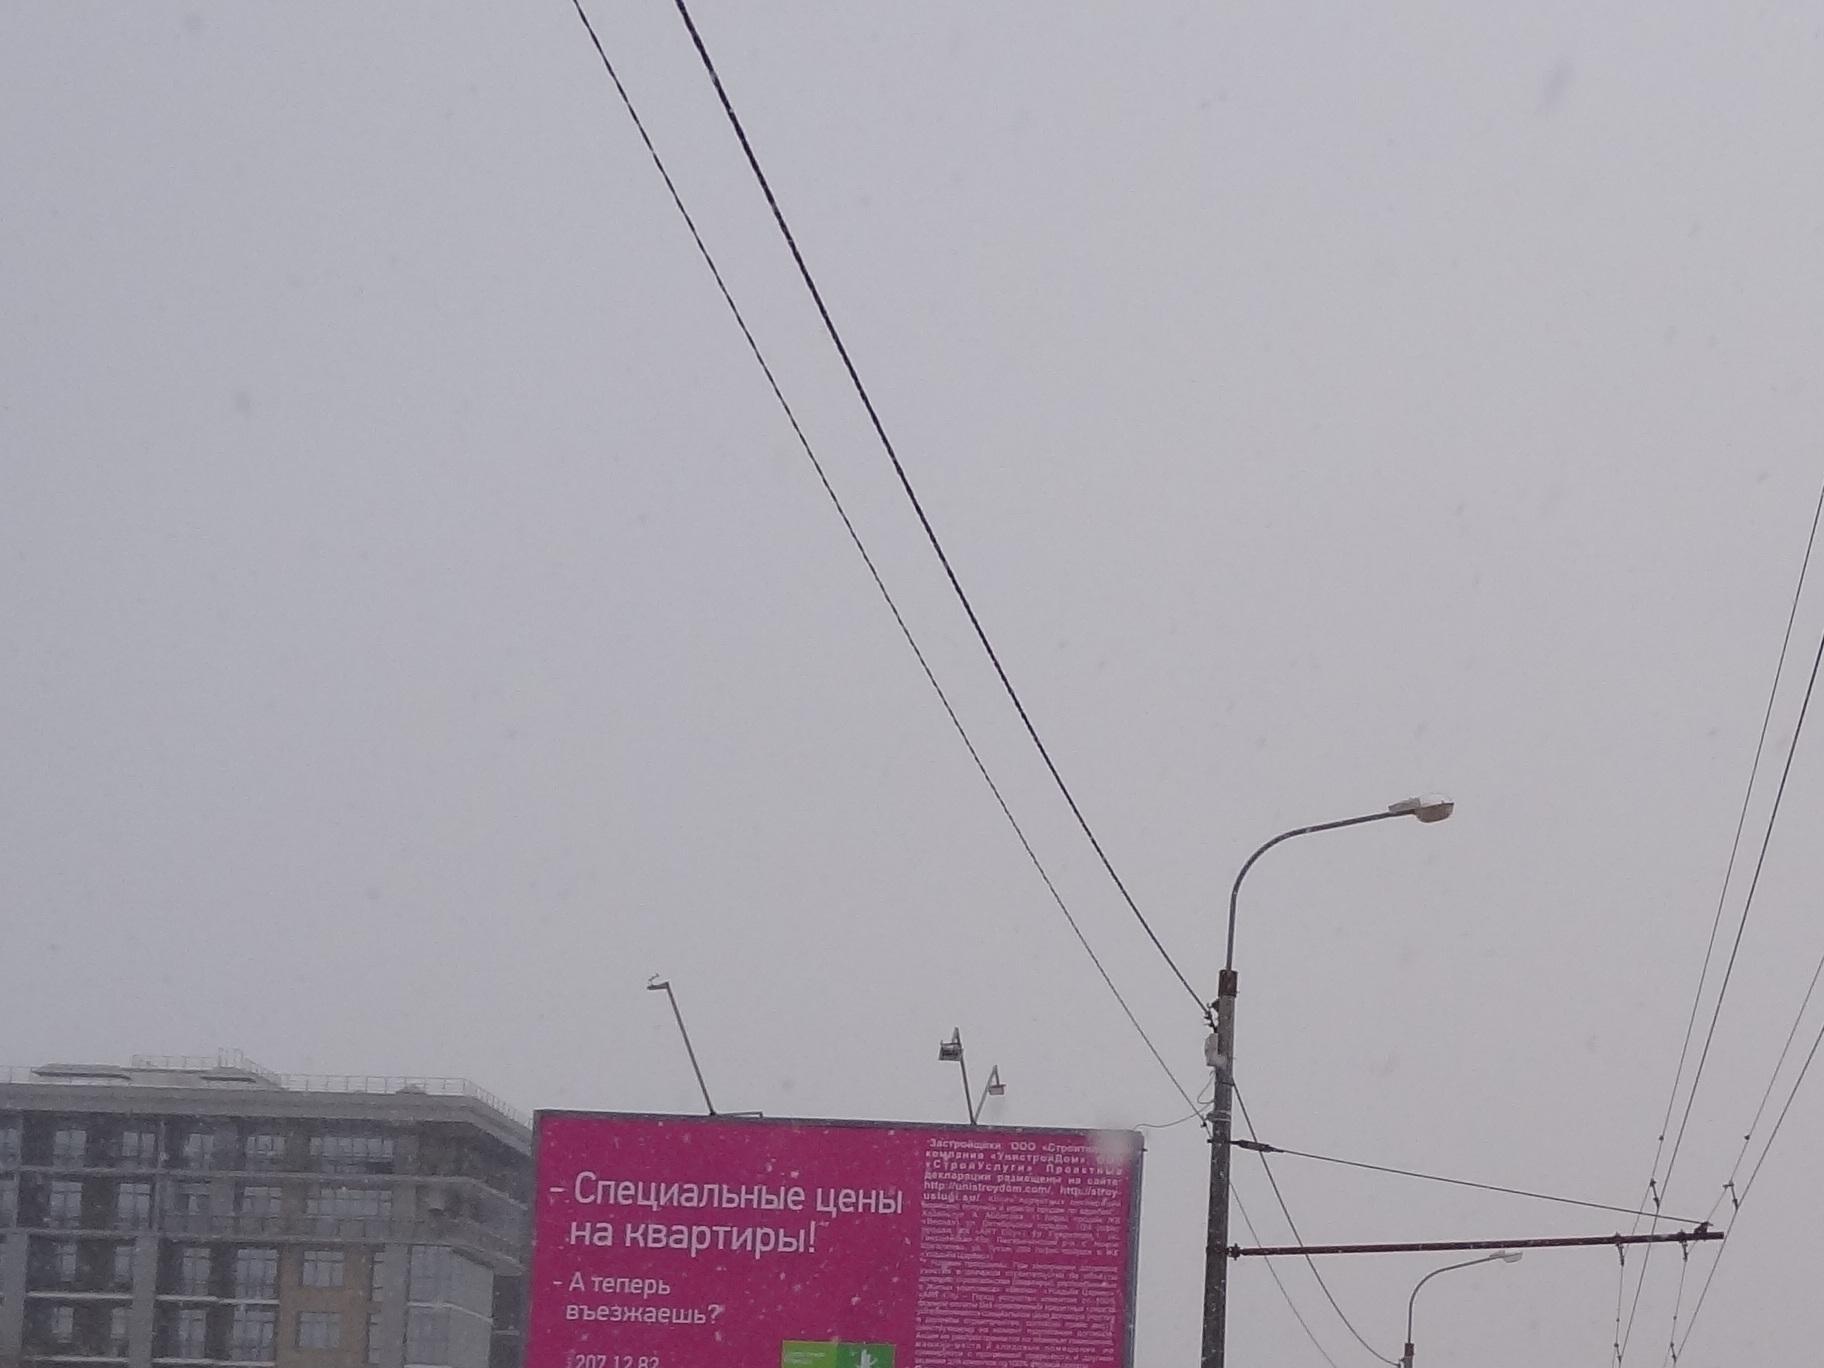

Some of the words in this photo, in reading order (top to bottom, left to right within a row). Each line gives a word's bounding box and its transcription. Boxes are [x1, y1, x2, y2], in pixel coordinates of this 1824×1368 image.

[574, 1170, 805, 1212] Специальные
[816, 1187, 903, 1219] цены
[569, 1221, 614, 1247] на
[624, 1220, 816, 1260] квартиры!
[568, 1271, 585, 1292] А
[591, 1276, 671, 1299] теперь
[565, 1303, 721, 1325] въезжаешь?
